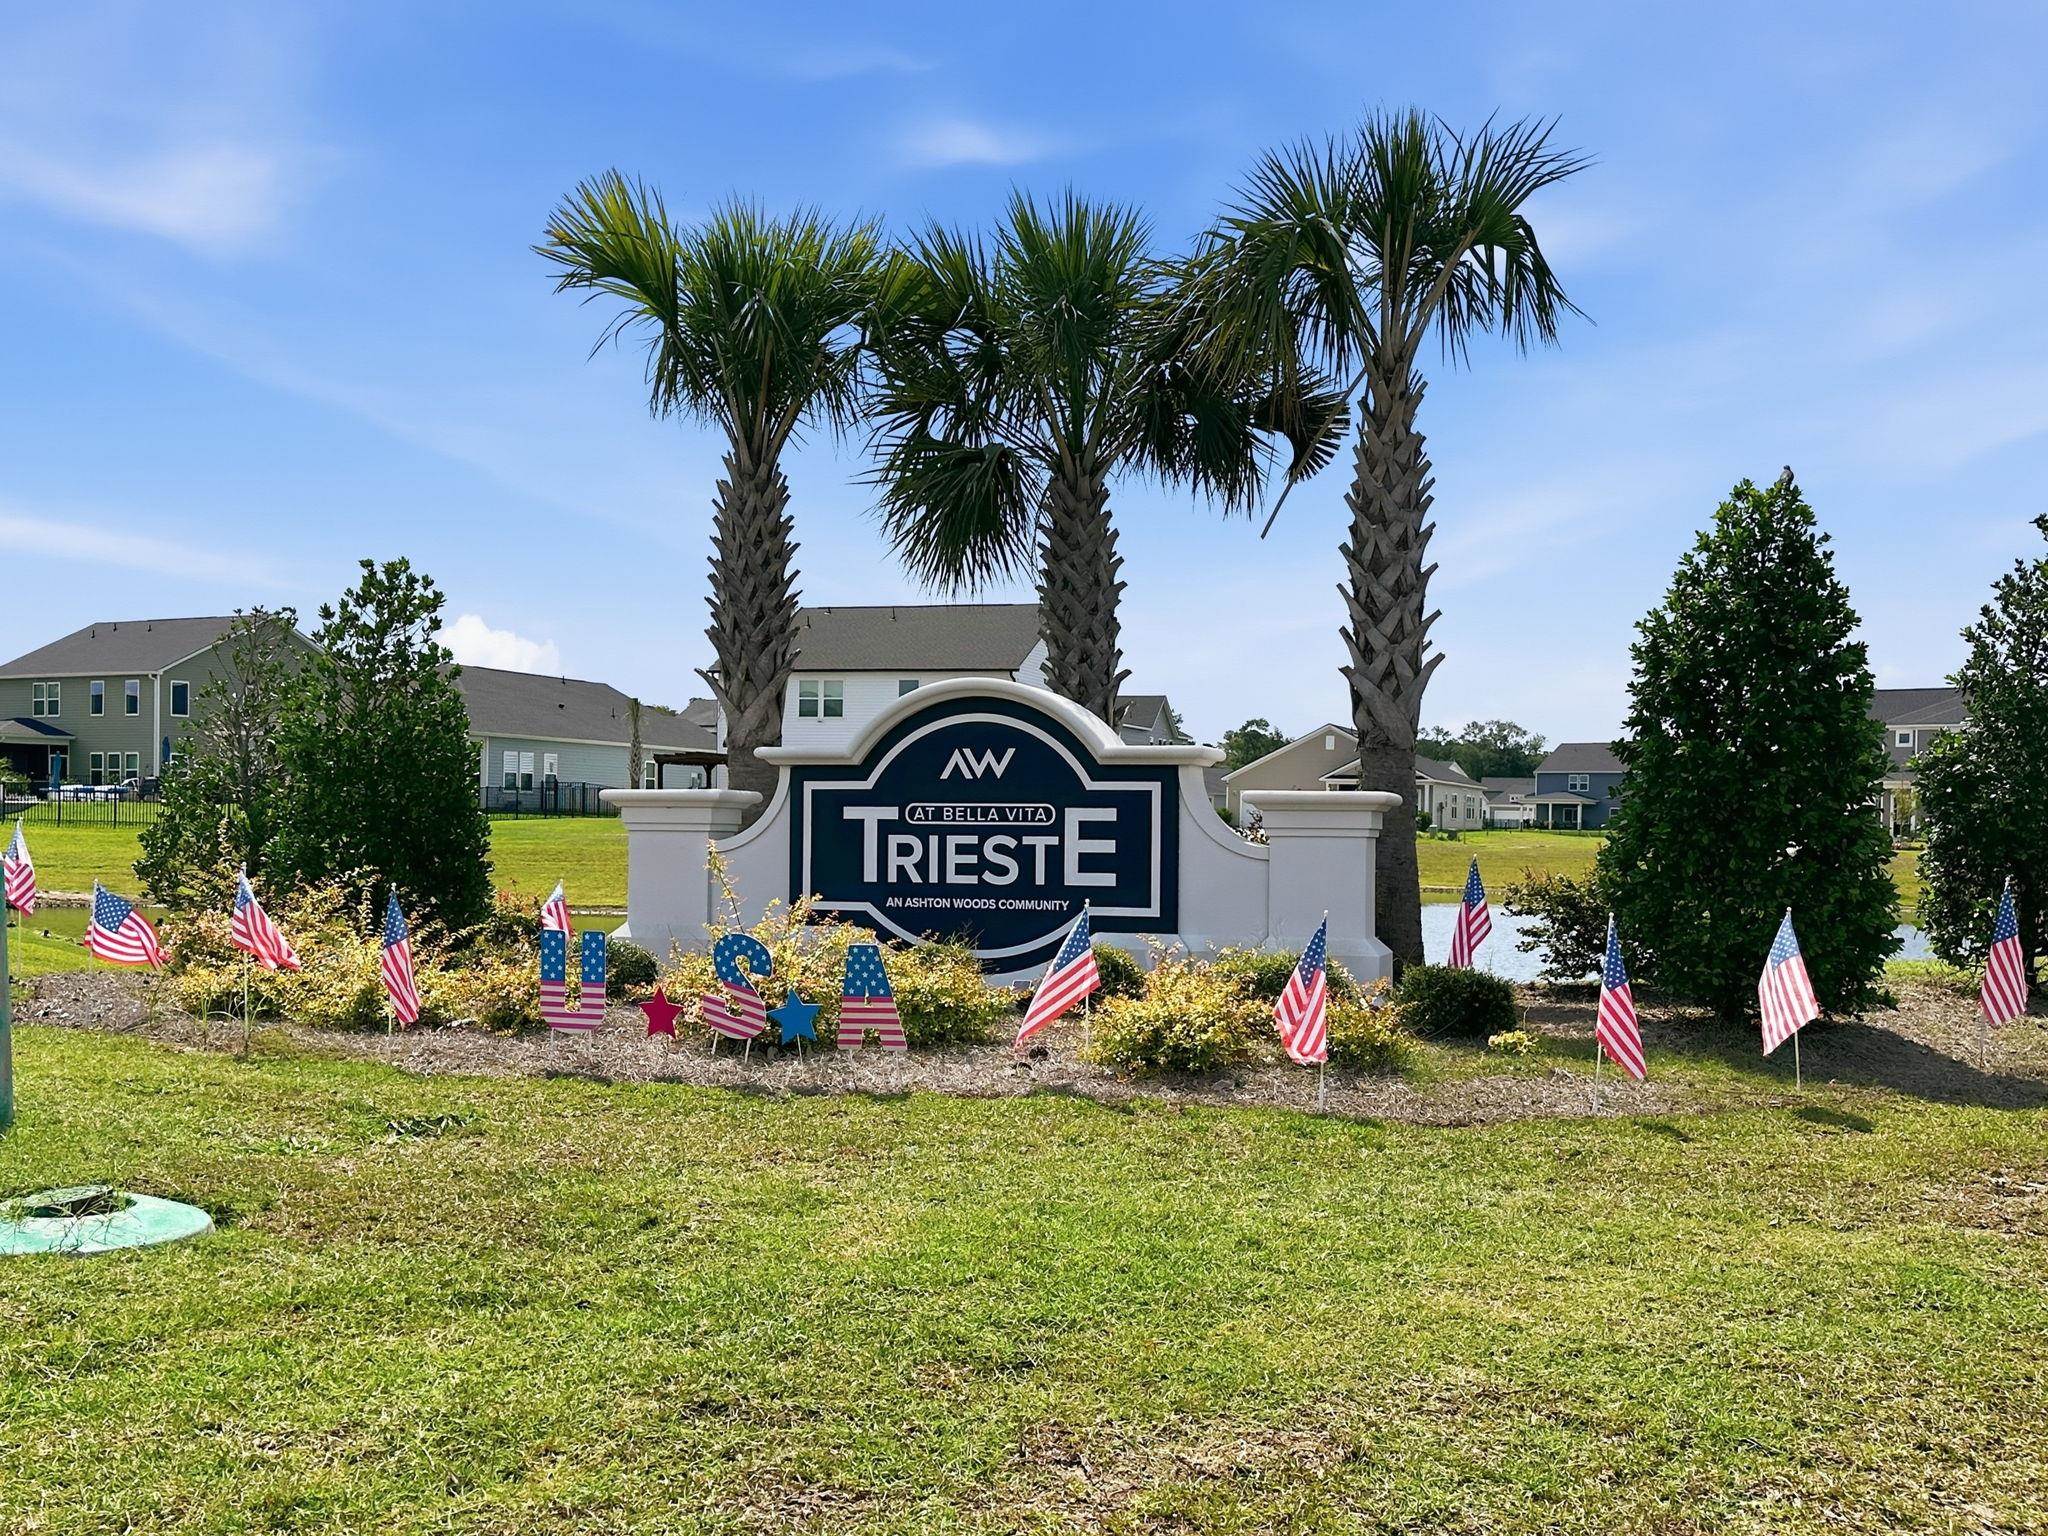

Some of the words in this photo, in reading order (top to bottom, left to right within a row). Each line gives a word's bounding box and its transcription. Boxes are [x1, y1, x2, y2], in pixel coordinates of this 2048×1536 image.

[913, 808, 935, 821] AT
[942, 807, 999, 821] BELLA
[1006, 808, 1047, 822] VITA
[842, 806, 1118, 887] TRIESTE
[886, 896, 903, 907] AN
[904, 897, 951, 909] ASHTON
[952, 897, 996, 910] WOODS
[997, 898, 1070, 911] COMMUNITY
